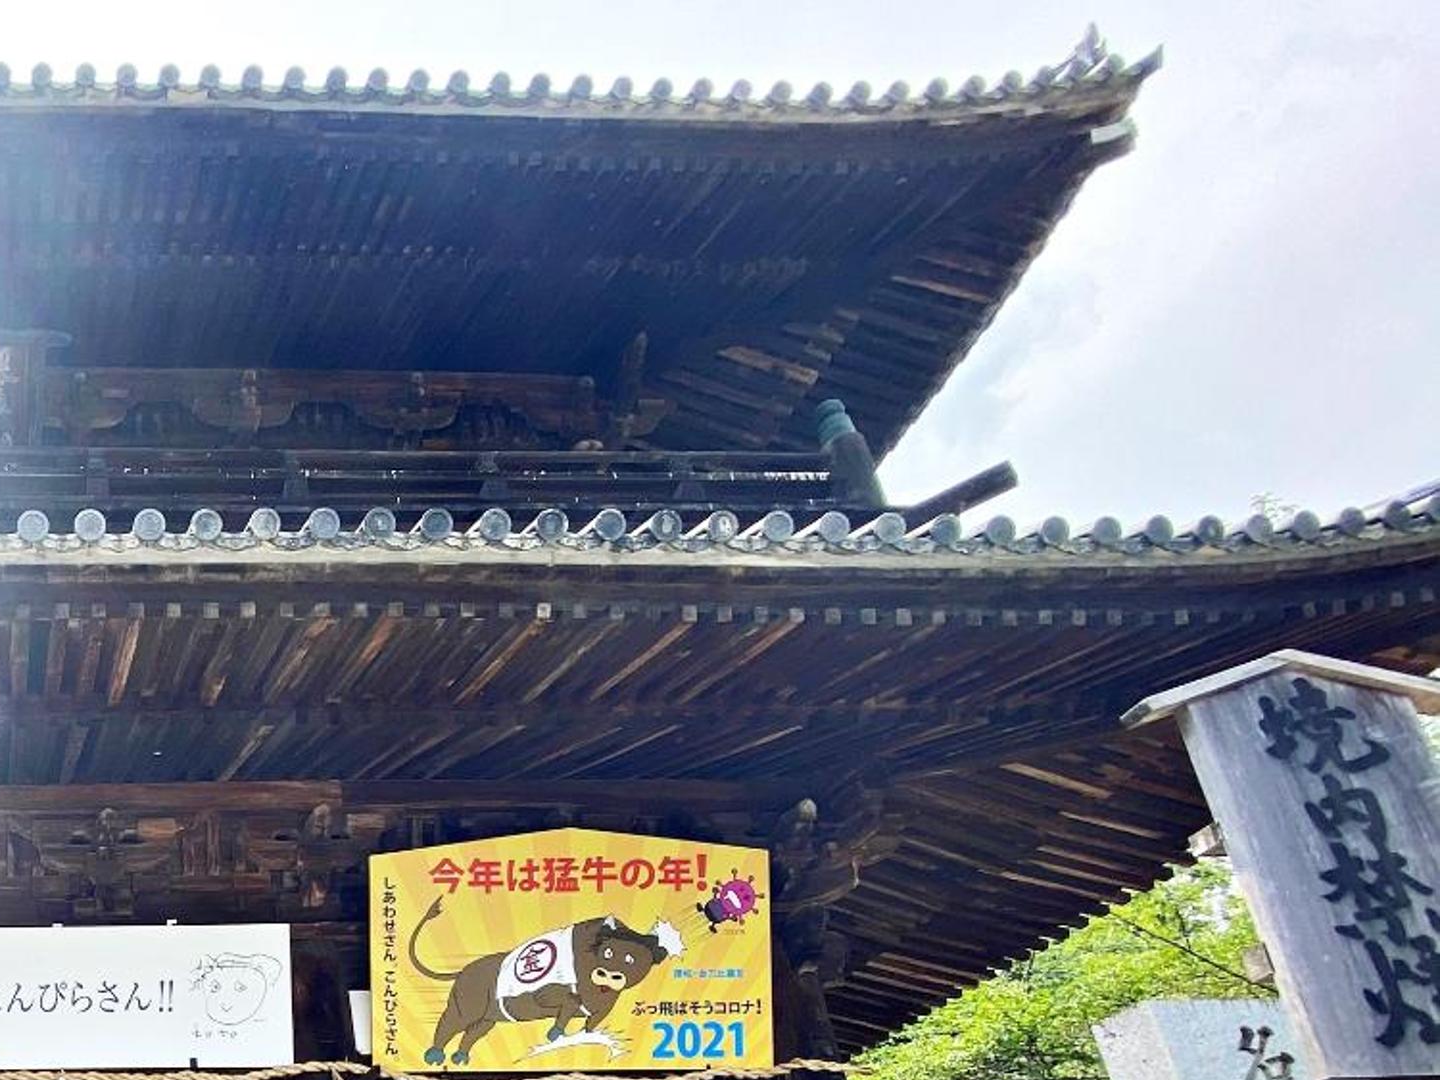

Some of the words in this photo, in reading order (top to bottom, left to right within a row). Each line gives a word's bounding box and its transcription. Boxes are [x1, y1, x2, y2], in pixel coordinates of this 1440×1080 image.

[428, 854, 708, 895] 今年は猛牛の年!
[651, 1021, 744, 1058] 2021
